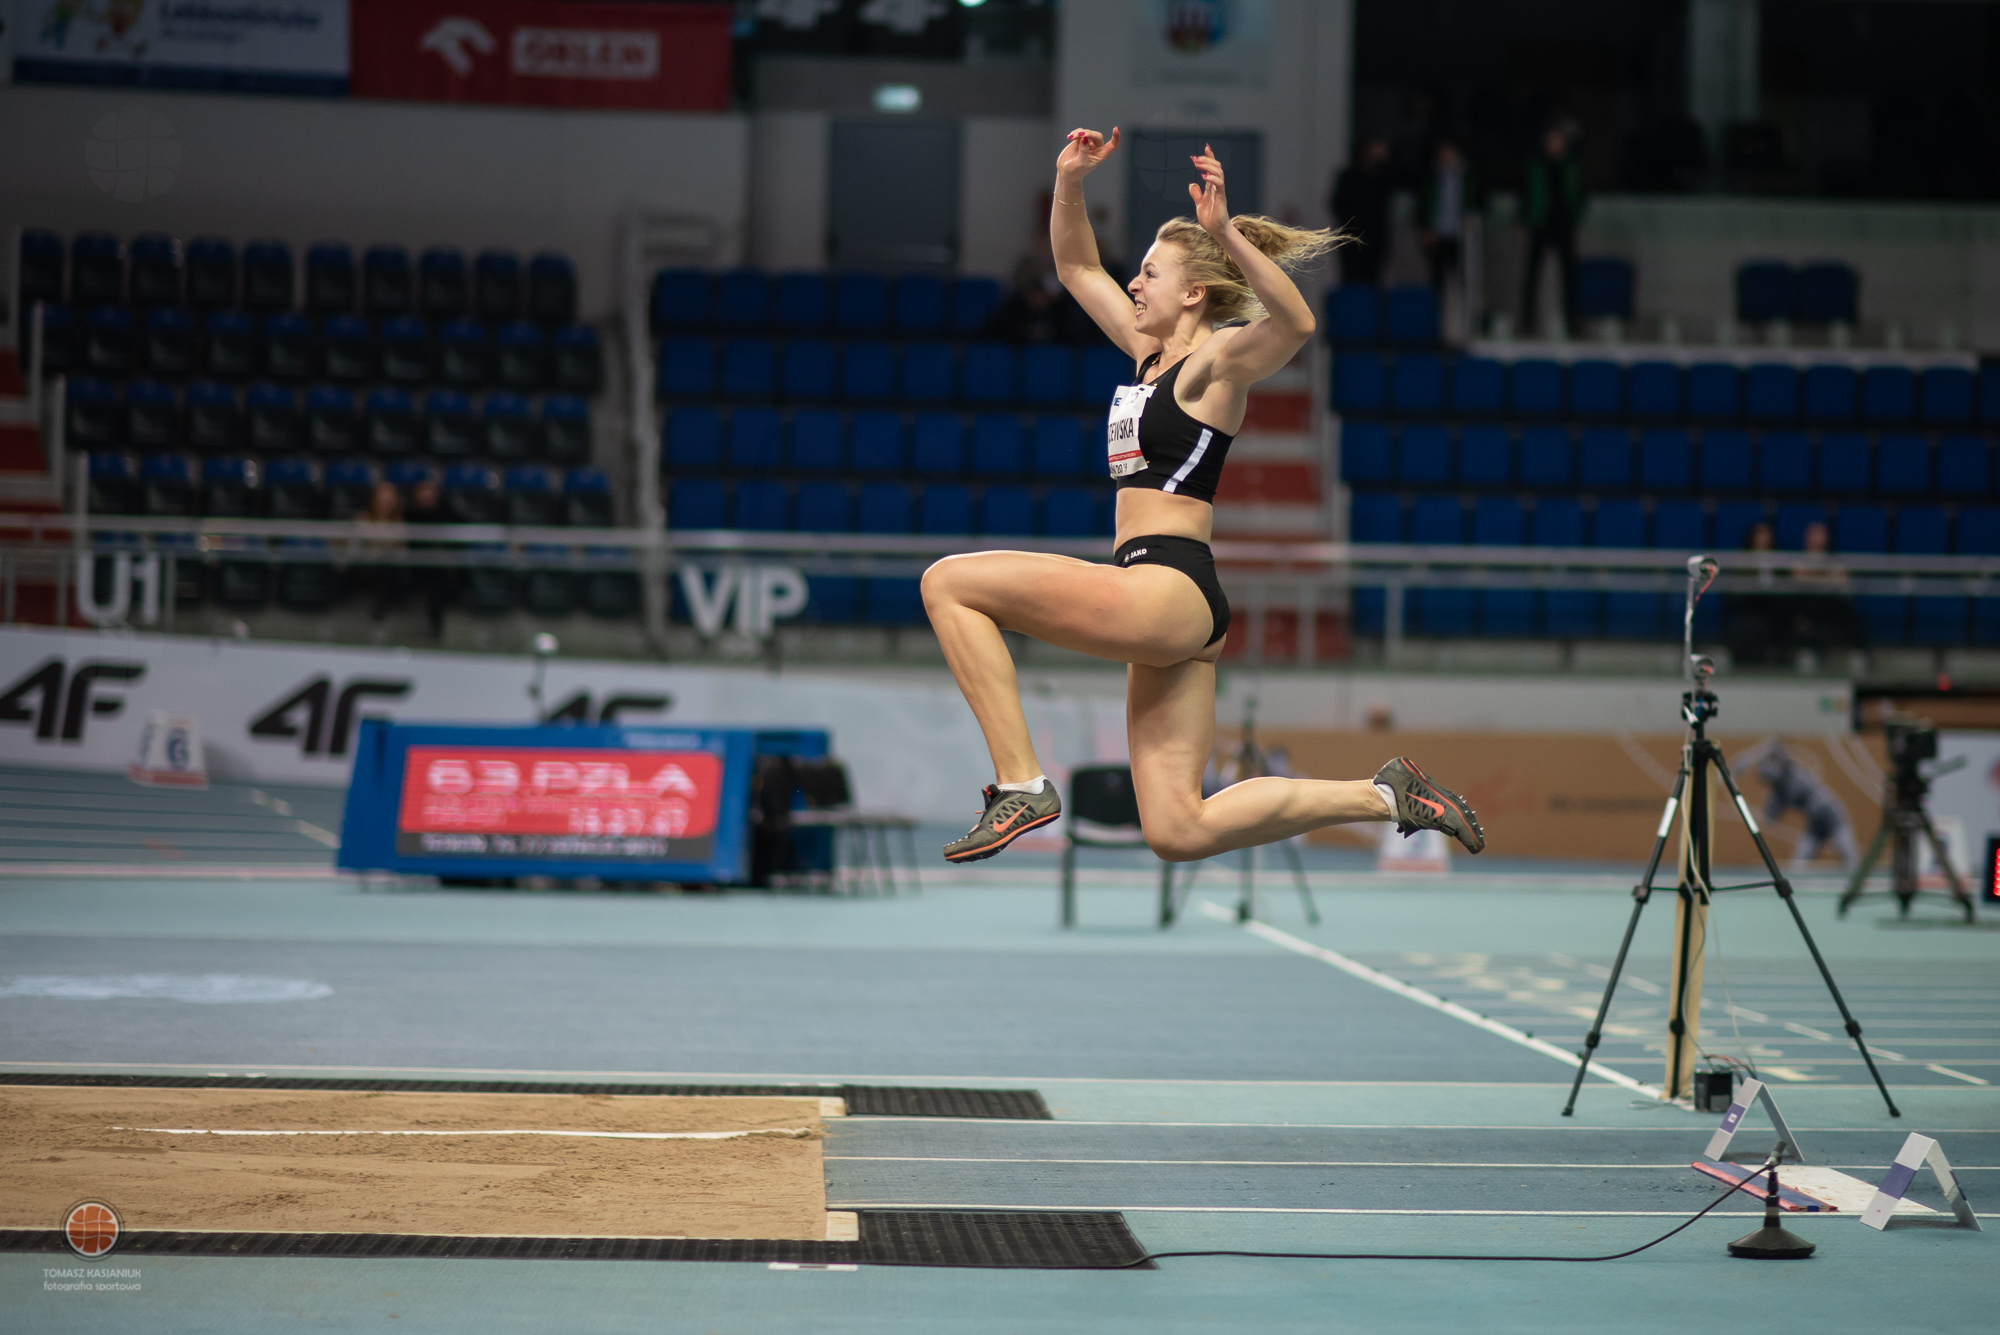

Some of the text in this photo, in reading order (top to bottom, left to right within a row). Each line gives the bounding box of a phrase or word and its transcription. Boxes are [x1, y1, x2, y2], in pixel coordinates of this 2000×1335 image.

[76, 551, 160, 627] U1
[1130, 548, 1147, 559] JAKO
[681, 564, 810, 638] VIP
[0, 656, 147, 741] 4F
